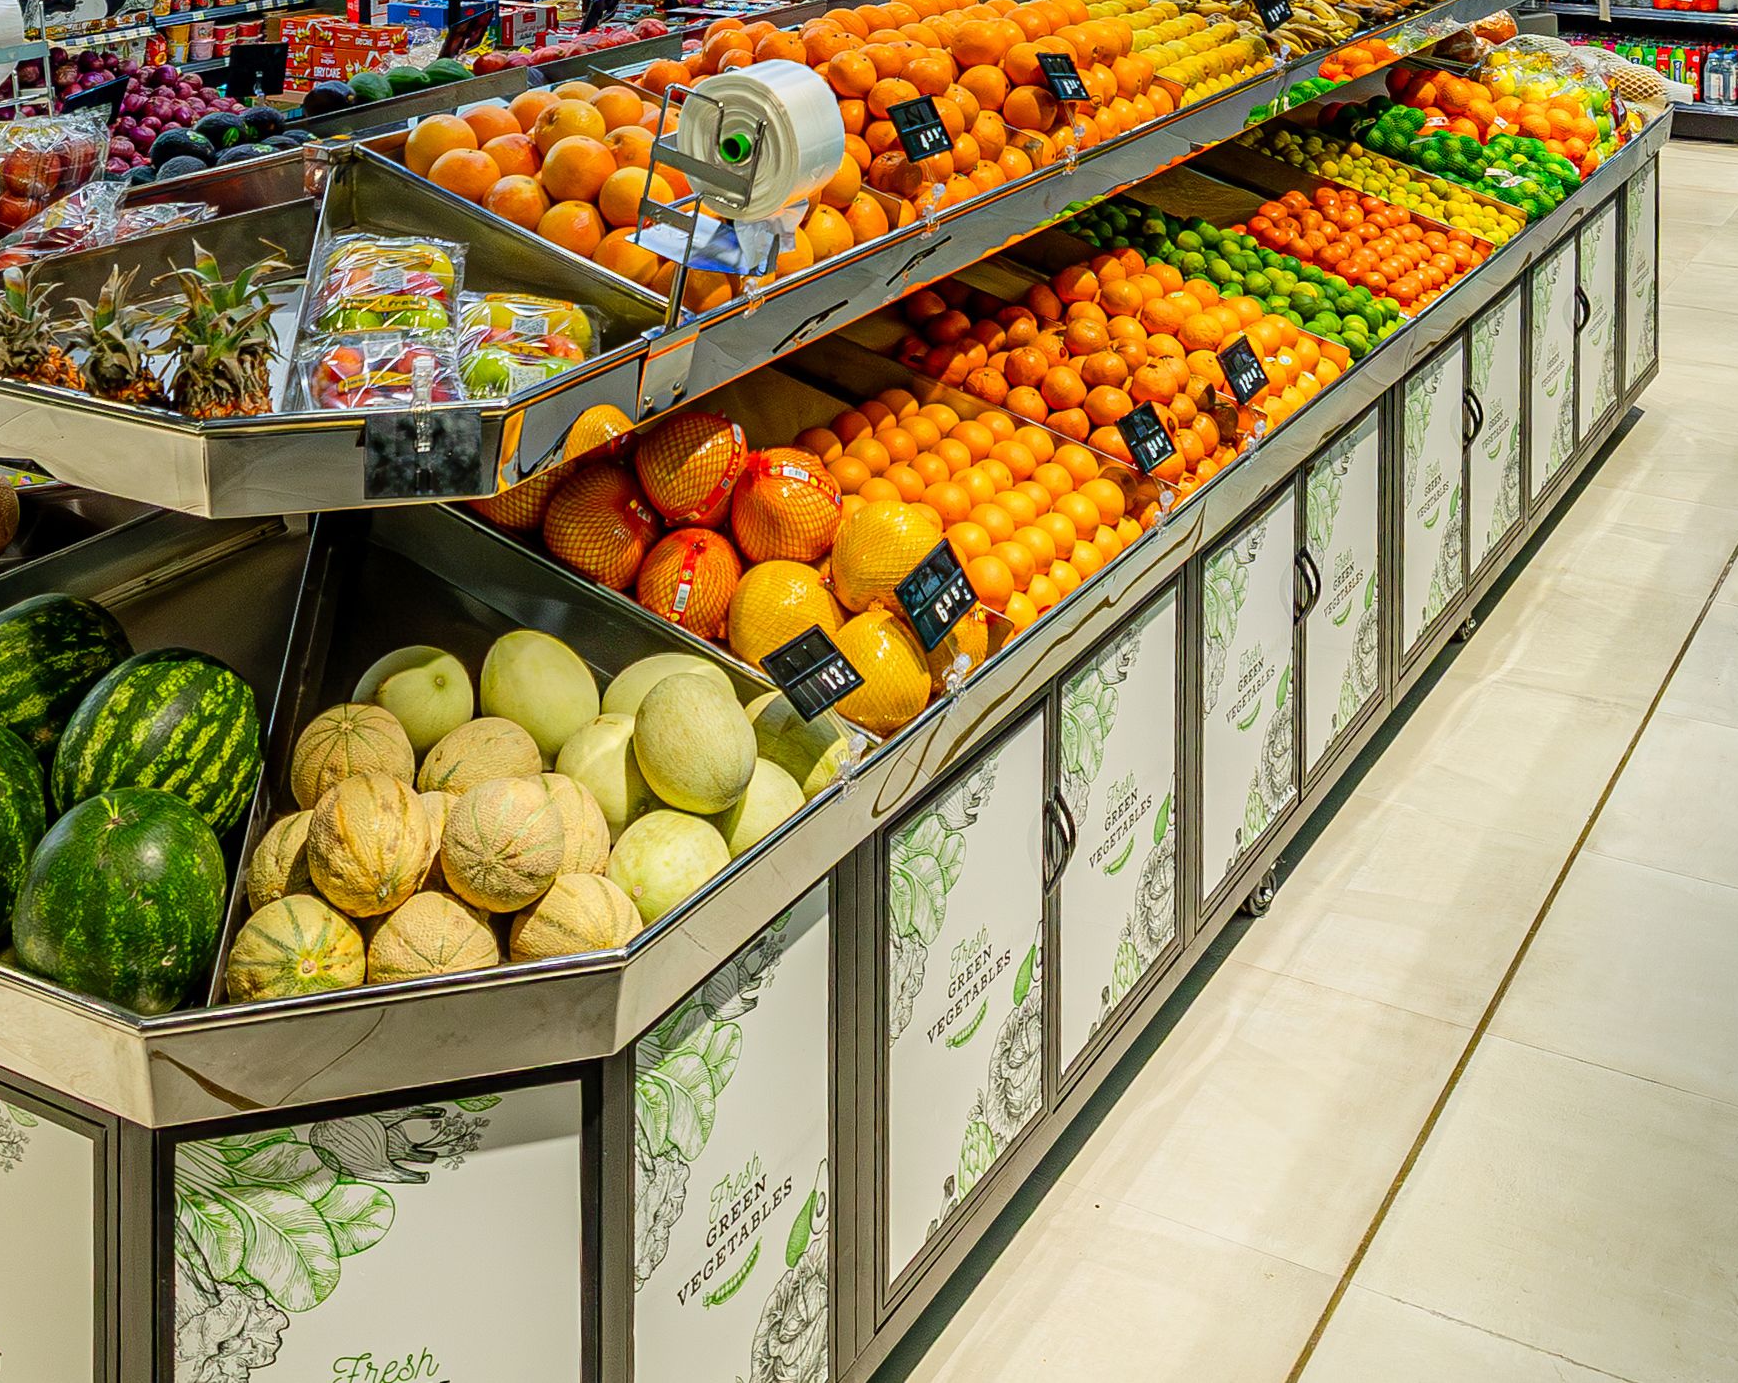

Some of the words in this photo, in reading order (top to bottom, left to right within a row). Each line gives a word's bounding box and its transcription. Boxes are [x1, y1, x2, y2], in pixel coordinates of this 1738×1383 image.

[1324, 568, 1364, 618] VEGETABLES
[1332, 561, 1355, 592] GREEN
[1225, 664, 1276, 724] VEGETABLES
[1237, 656, 1264, 693] GREEN
[1103, 788, 1139, 832] GREEN
[1105, 769, 1134, 816] Fresh
[1088, 794, 1153, 869] VEGETABLES
[947, 943, 993, 999] GREEN
[950, 923, 990, 979] Fresh
[926, 949, 1012, 1045] VEGETABLES
[705, 1173, 767, 1250] GREEN
[708, 1150, 762, 1224] Fresh
[676, 1176, 793, 1308] VEGETABLES
[332, 1346, 440, 1383] Fresh
